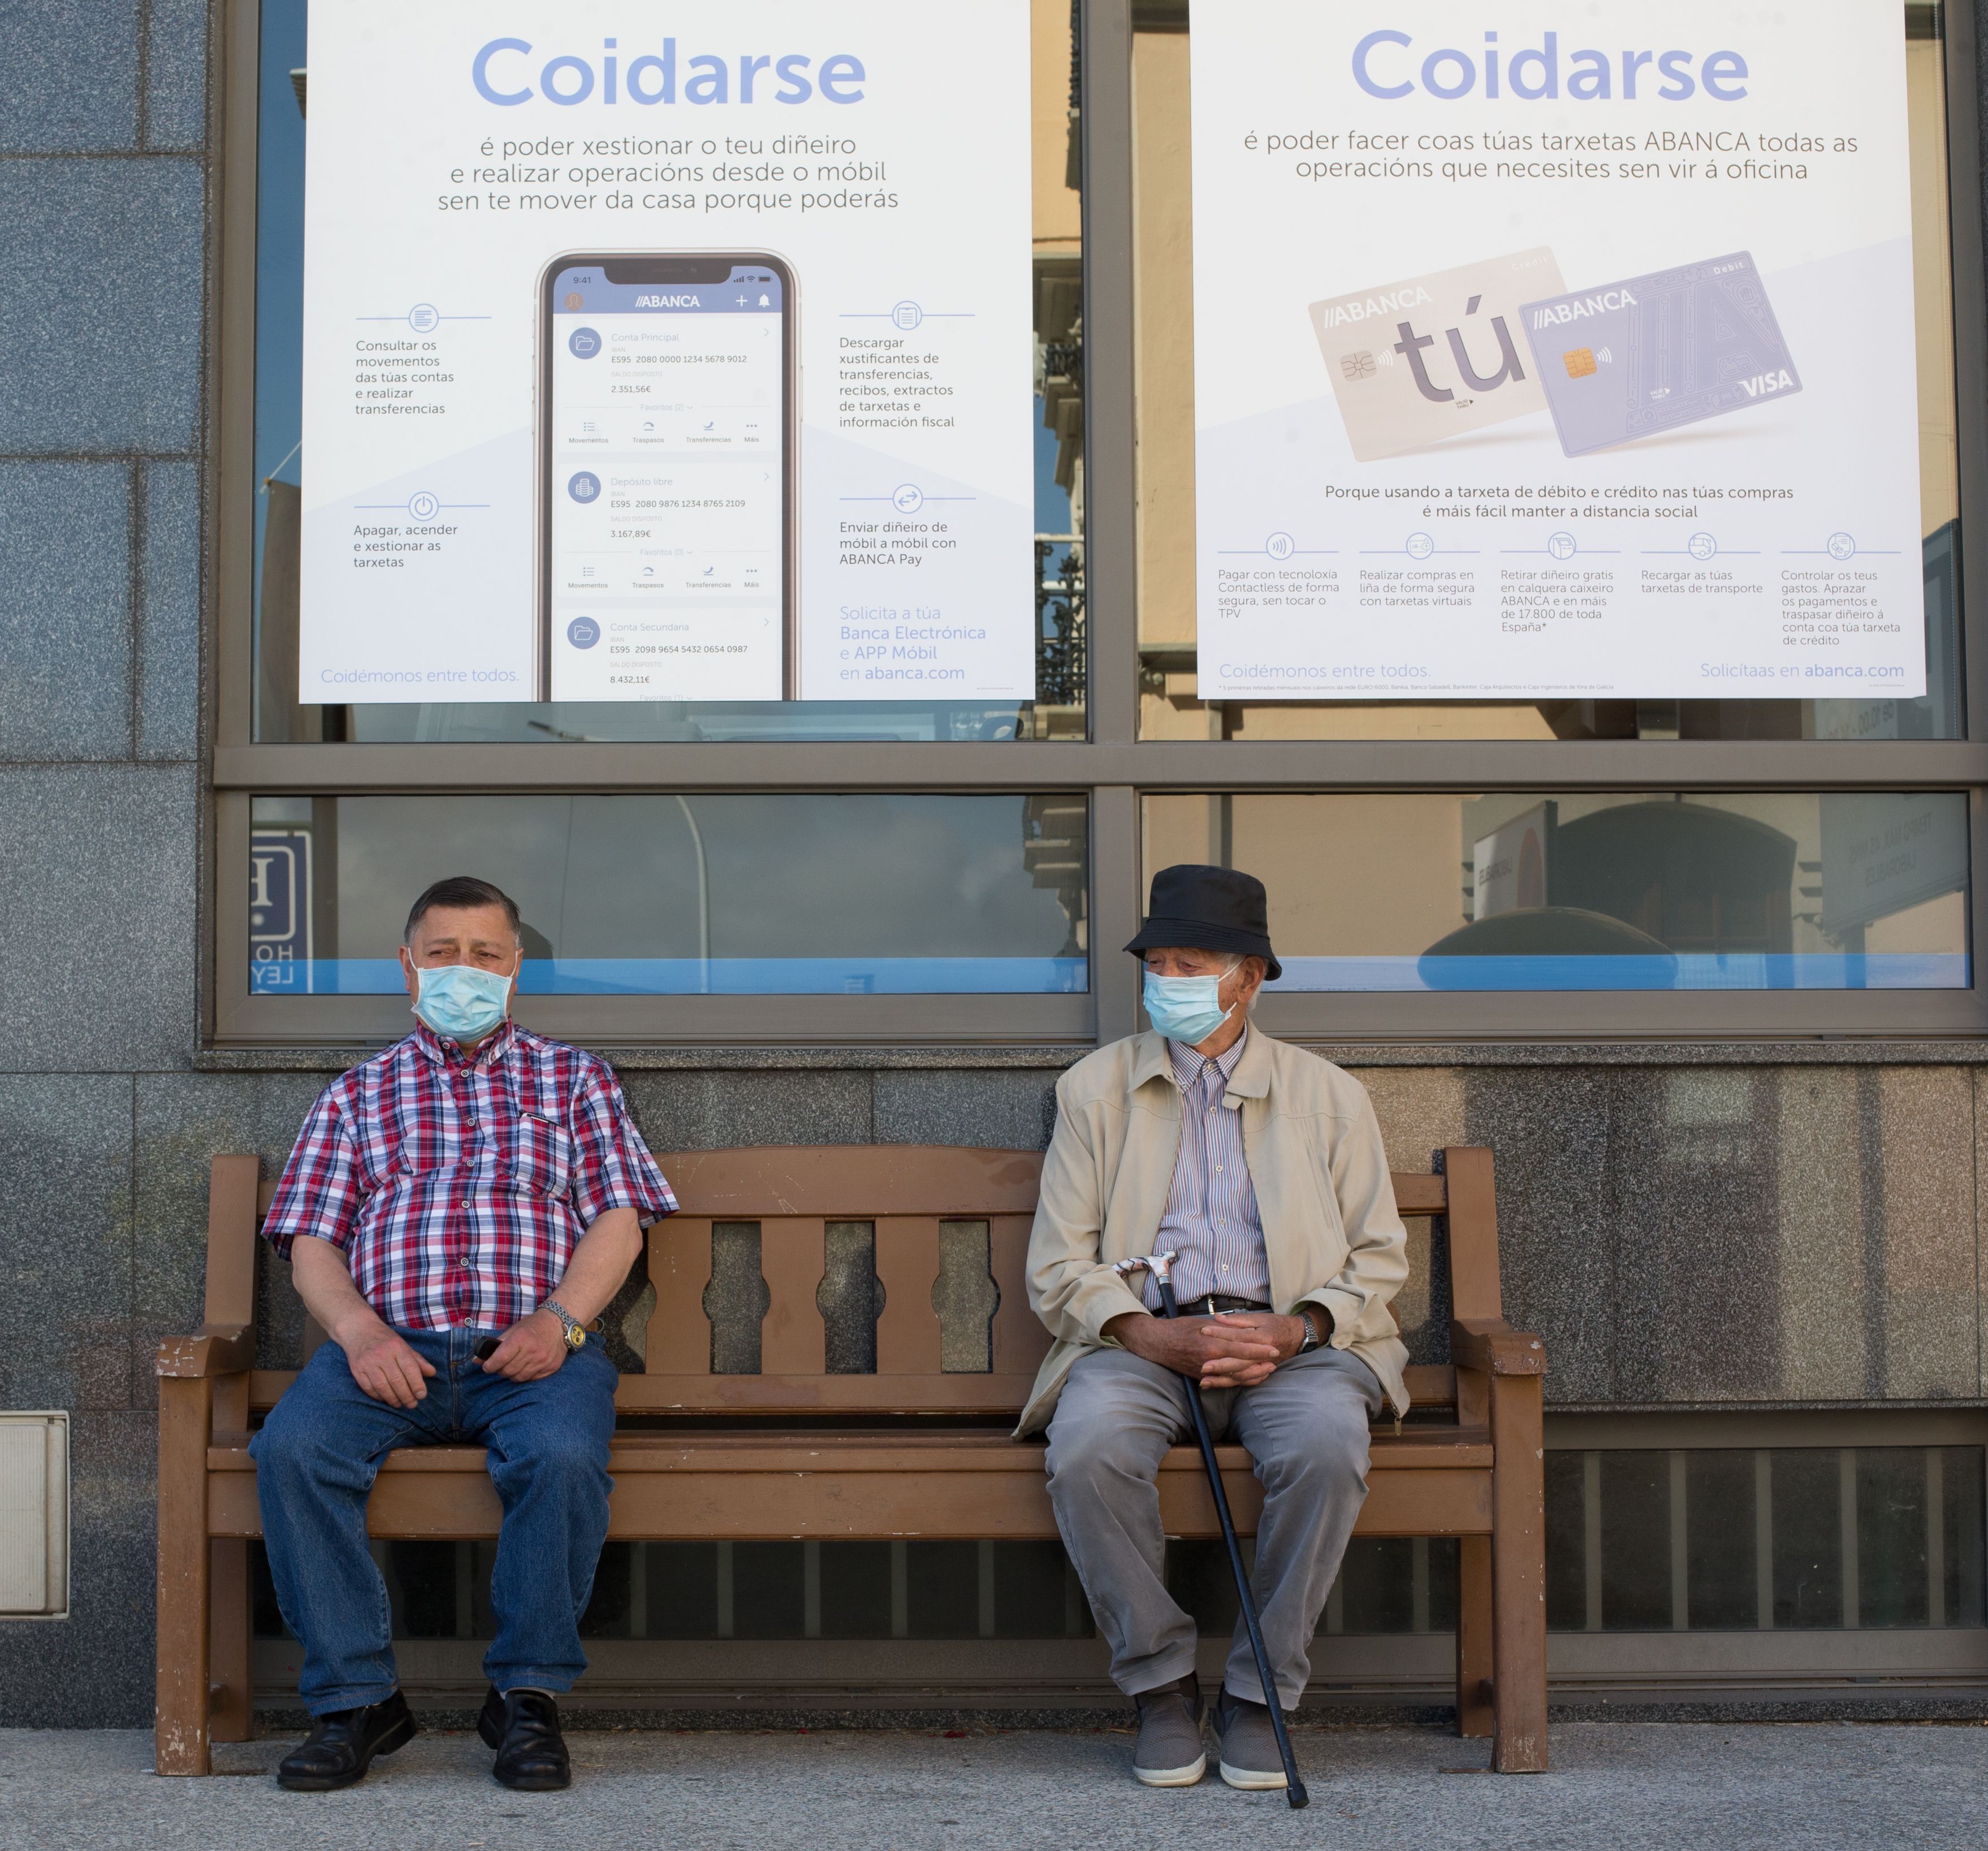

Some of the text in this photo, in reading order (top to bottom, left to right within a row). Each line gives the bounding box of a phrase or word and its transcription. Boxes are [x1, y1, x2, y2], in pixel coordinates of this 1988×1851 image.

[1352, 30, 1748, 101] Coidarse
[472, 38, 865, 106] Coidarse
[481, 135, 855, 161] é poder xestionar o teu diñeiro
[1244, 130, 1857, 154] é poder facer coas túas tarxetas ABANCA todas as
[1296, 158, 1807, 182] operacións que necesites sen vir á oficina
[439, 188, 898, 213] sen te mover da casa porque poderás
[1511, 256, 1548, 271] Credit
[1713, 261, 1745, 274] Debit
[642, 334, 678, 343] Principal
[840, 338, 904, 350] Descargar
[356, 340, 418, 351] Consultar
[1393, 295, 1525, 403] tú
[356, 357, 439, 366] movementos
[840, 353, 939, 364] xustificantes de
[1738, 369, 1793, 397] VISA
[840, 385, 953, 396] recibos, extractos
[356, 404, 445, 415] transferencias
[840, 417, 954, 427] información fiscal
[611, 478, 651, 487] Depósito
[1326, 486, 1793, 501] Porque usando a tarxeta de débito e crédito nas túas compras
[354, 525, 457, 538] Apagar, acender
[841, 522, 947, 532] Enviar diñeiro de
[354, 558, 404, 567] tarxetas
[840, 554, 922, 567] ABANCA Pay
[1219, 569, 1250, 581] Pagar
[1279, 569, 1337, 579] tecnoloxía
[1502, 570, 1613, 582] Retirar diñeiro gratis
[1782, 571, 1834, 580] Controlar
[1855, 572, 1877, 580] teus
[1218, 583, 1339, 592] Contactless de forma
[1360, 583, 1474, 595] liña de forma segura
[1642, 584, 1762, 595] tarxetas de transporte
[1218, 609, 1241, 618] TPV
[1783, 610, 1883, 621] traspasar diñeiro á
[841, 626, 986, 640] Banca Electrónica
[840, 646, 937, 659] e APP Móbil
[321, 668, 519, 683] Coidémonos entre todos.
[840, 666, 964, 679] en abanca.com
[1220, 663, 1431, 678] Coidémonos entre todos.
[1701, 663, 1904, 677] Solicítaas en abanca.com
